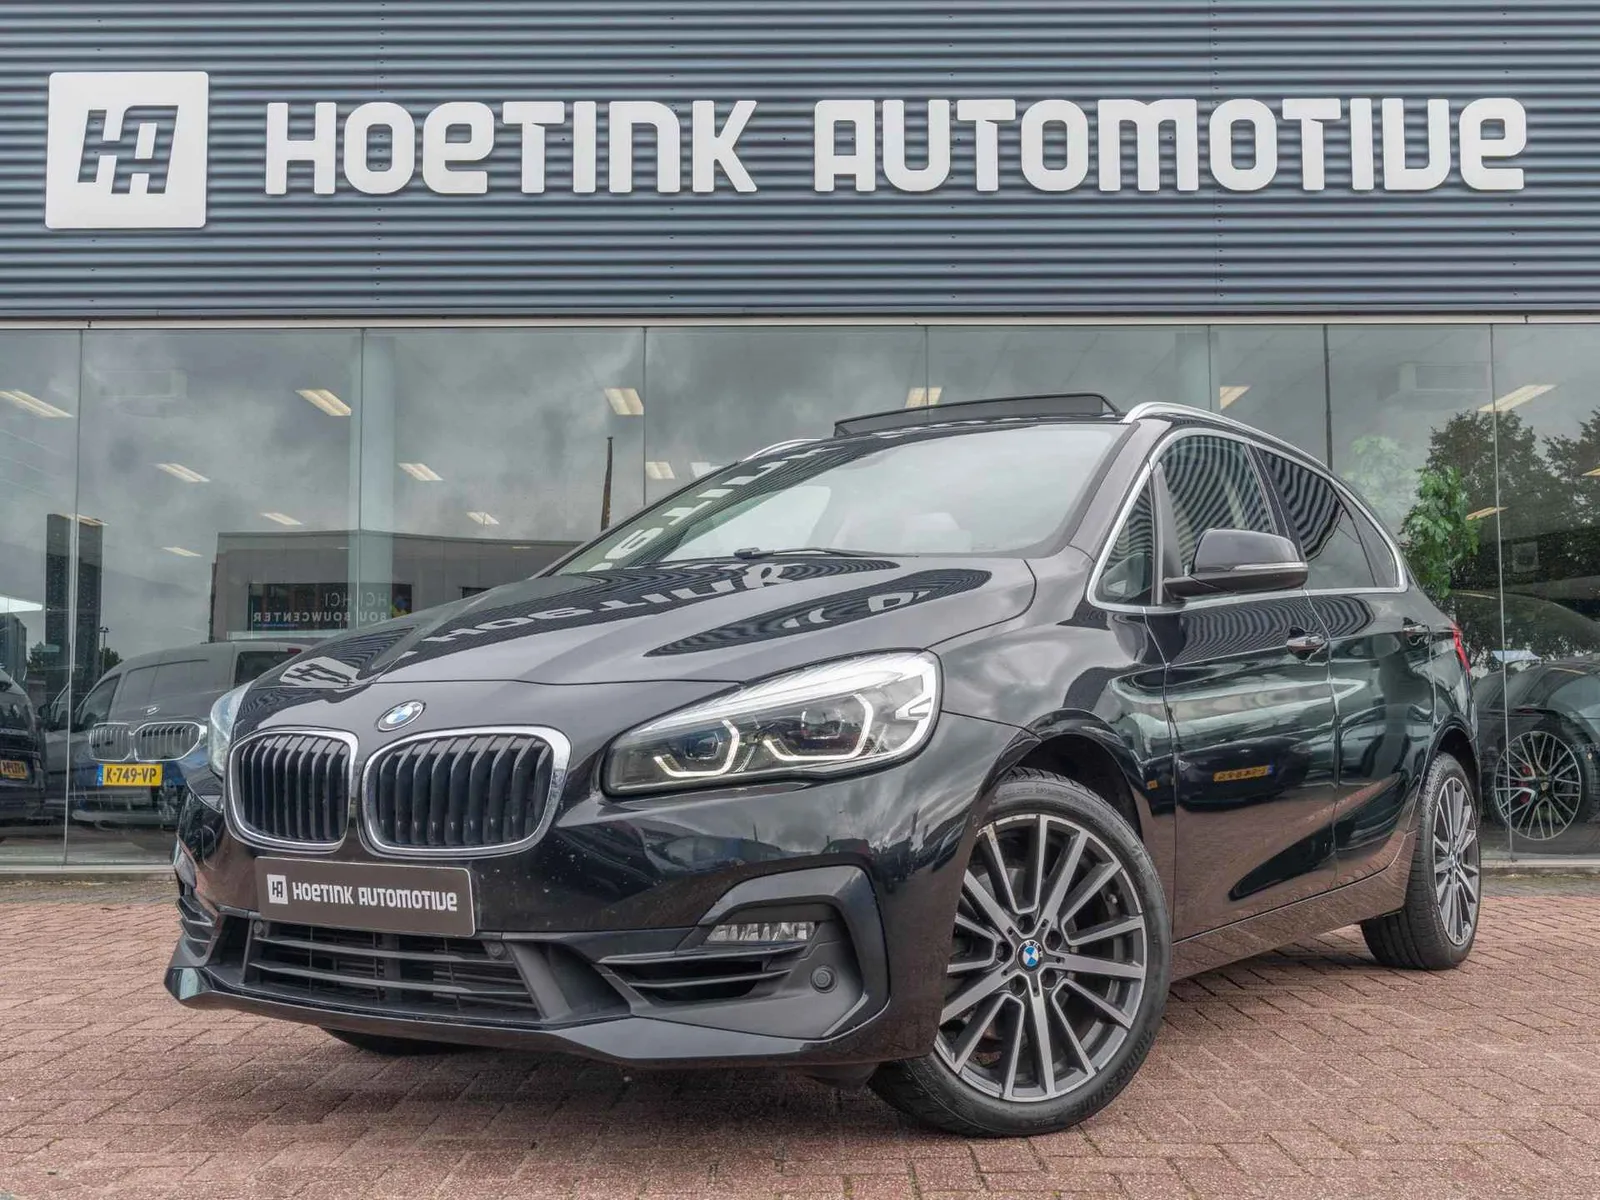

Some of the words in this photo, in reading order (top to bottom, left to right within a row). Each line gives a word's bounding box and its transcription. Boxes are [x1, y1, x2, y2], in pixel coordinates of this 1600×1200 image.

[265, 100, 758, 195] HOETINK
[813, 97, 1527, 192] AUTOMOTIVE
[106, 766, 157, 783] K-749-VP
[292, 881, 354, 905] HOETINK
[358, 886, 458, 912] AUTOMOTIVE
